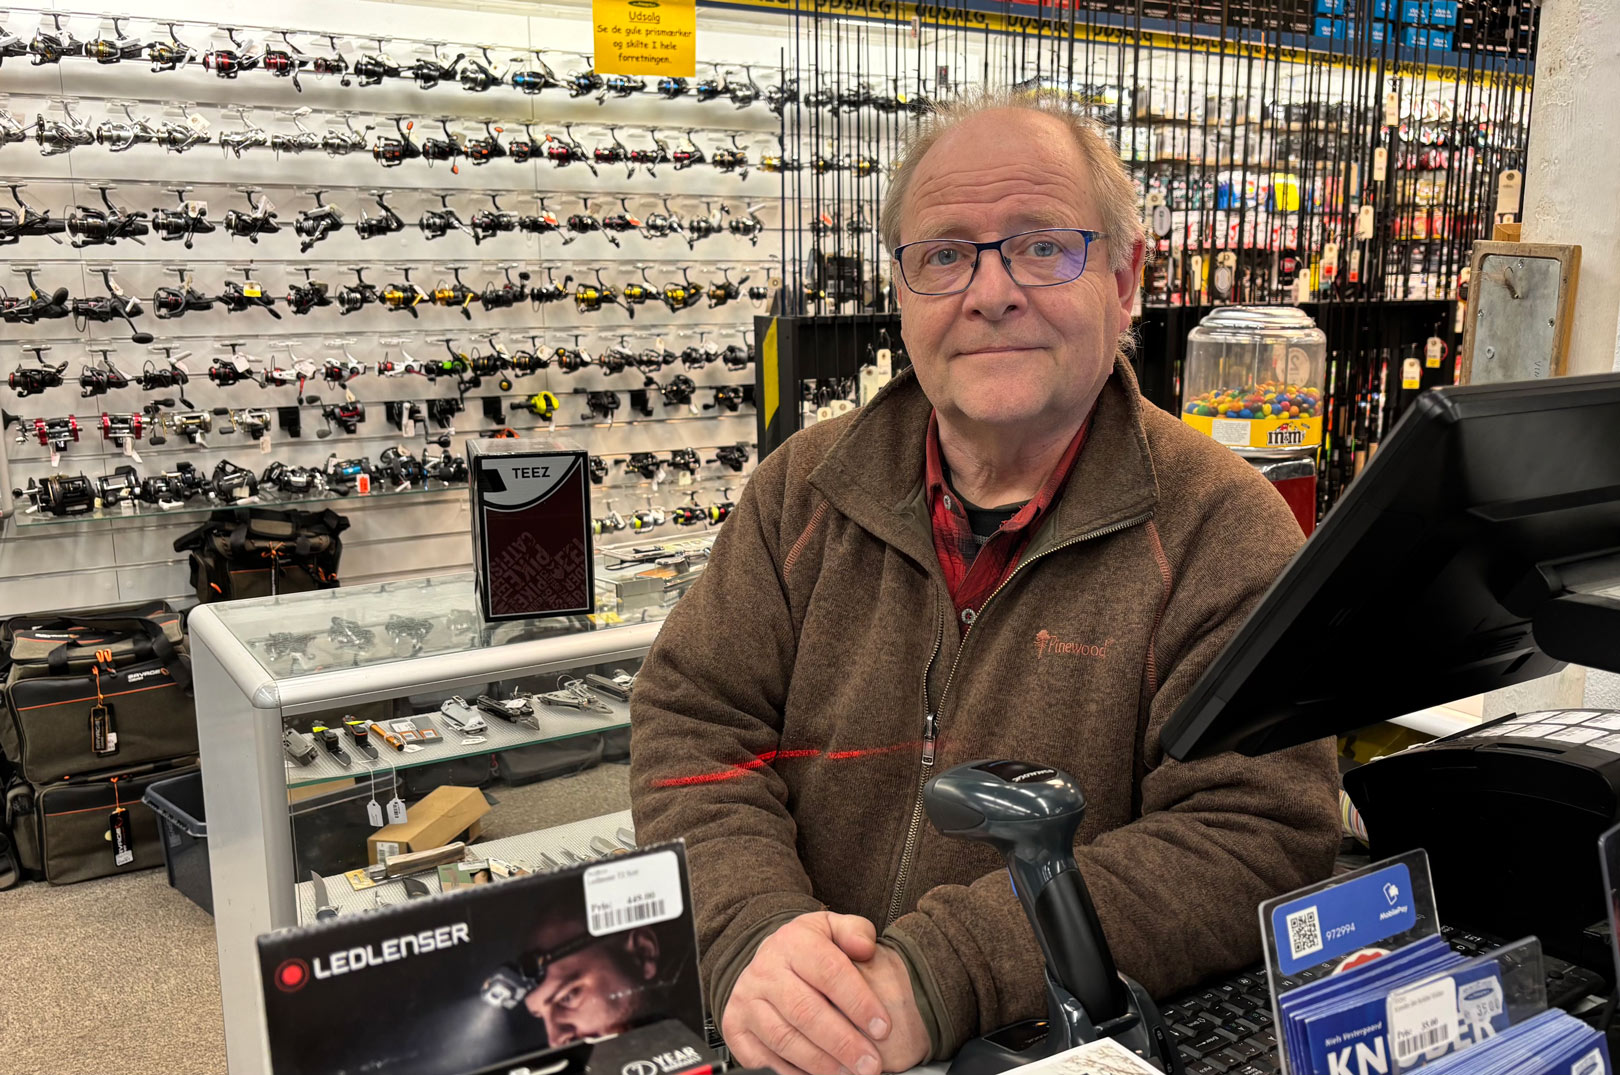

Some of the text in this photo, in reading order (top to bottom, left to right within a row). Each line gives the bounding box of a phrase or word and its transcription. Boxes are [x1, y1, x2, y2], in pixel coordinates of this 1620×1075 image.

[629, 11, 660, 23] Udsalg
[597, 25, 692, 38] Se de gule prismærker
[613, 40, 677, 50] og skilte I hele
[512, 467, 551, 479] TEEZ
[1048, 635, 1108, 658] Pinewood
[1380, 905, 1408, 920] MobilePay
[1326, 922, 1356, 940] 972994
[313, 922, 470, 980] LEDLENSER
[1325, 1021, 1383, 1047] Niels Vestergaard
